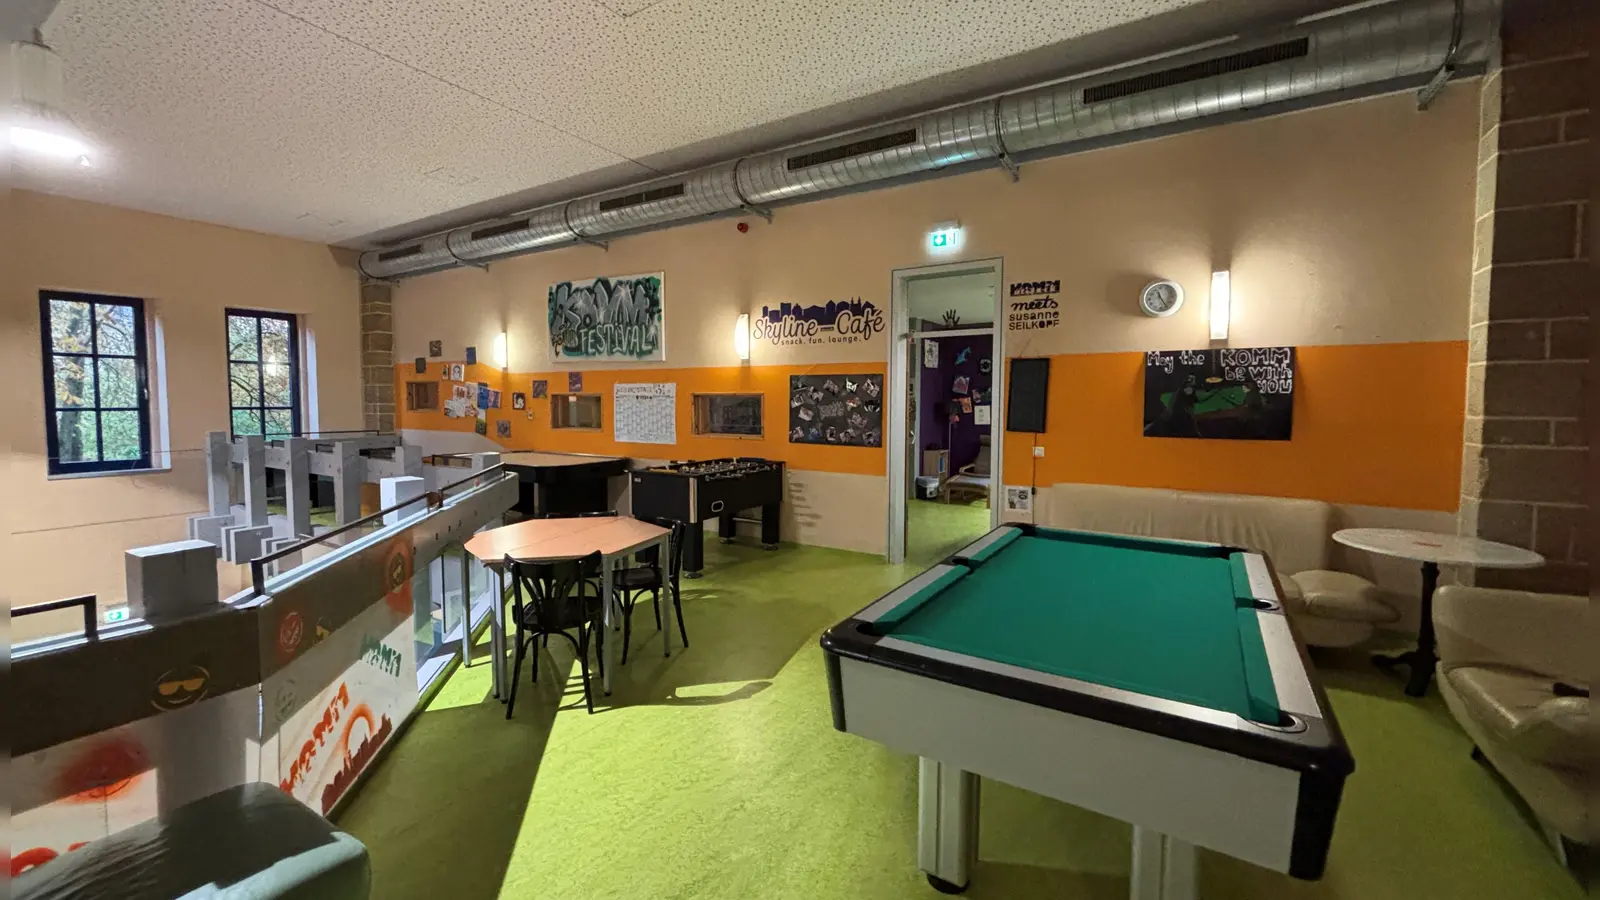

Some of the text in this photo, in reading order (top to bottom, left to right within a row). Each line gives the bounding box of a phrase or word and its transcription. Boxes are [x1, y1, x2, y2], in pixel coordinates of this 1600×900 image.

[1011, 295, 1059, 311] meets
[1009, 311, 1059, 321] susanne
[753, 308, 885, 345] Skyline Café
[1009, 320, 1060, 331] SEILKOPF
[781, 335, 862, 346] snack. fun. lounge.
[1147, 348, 1291, 374] May the KOMM
